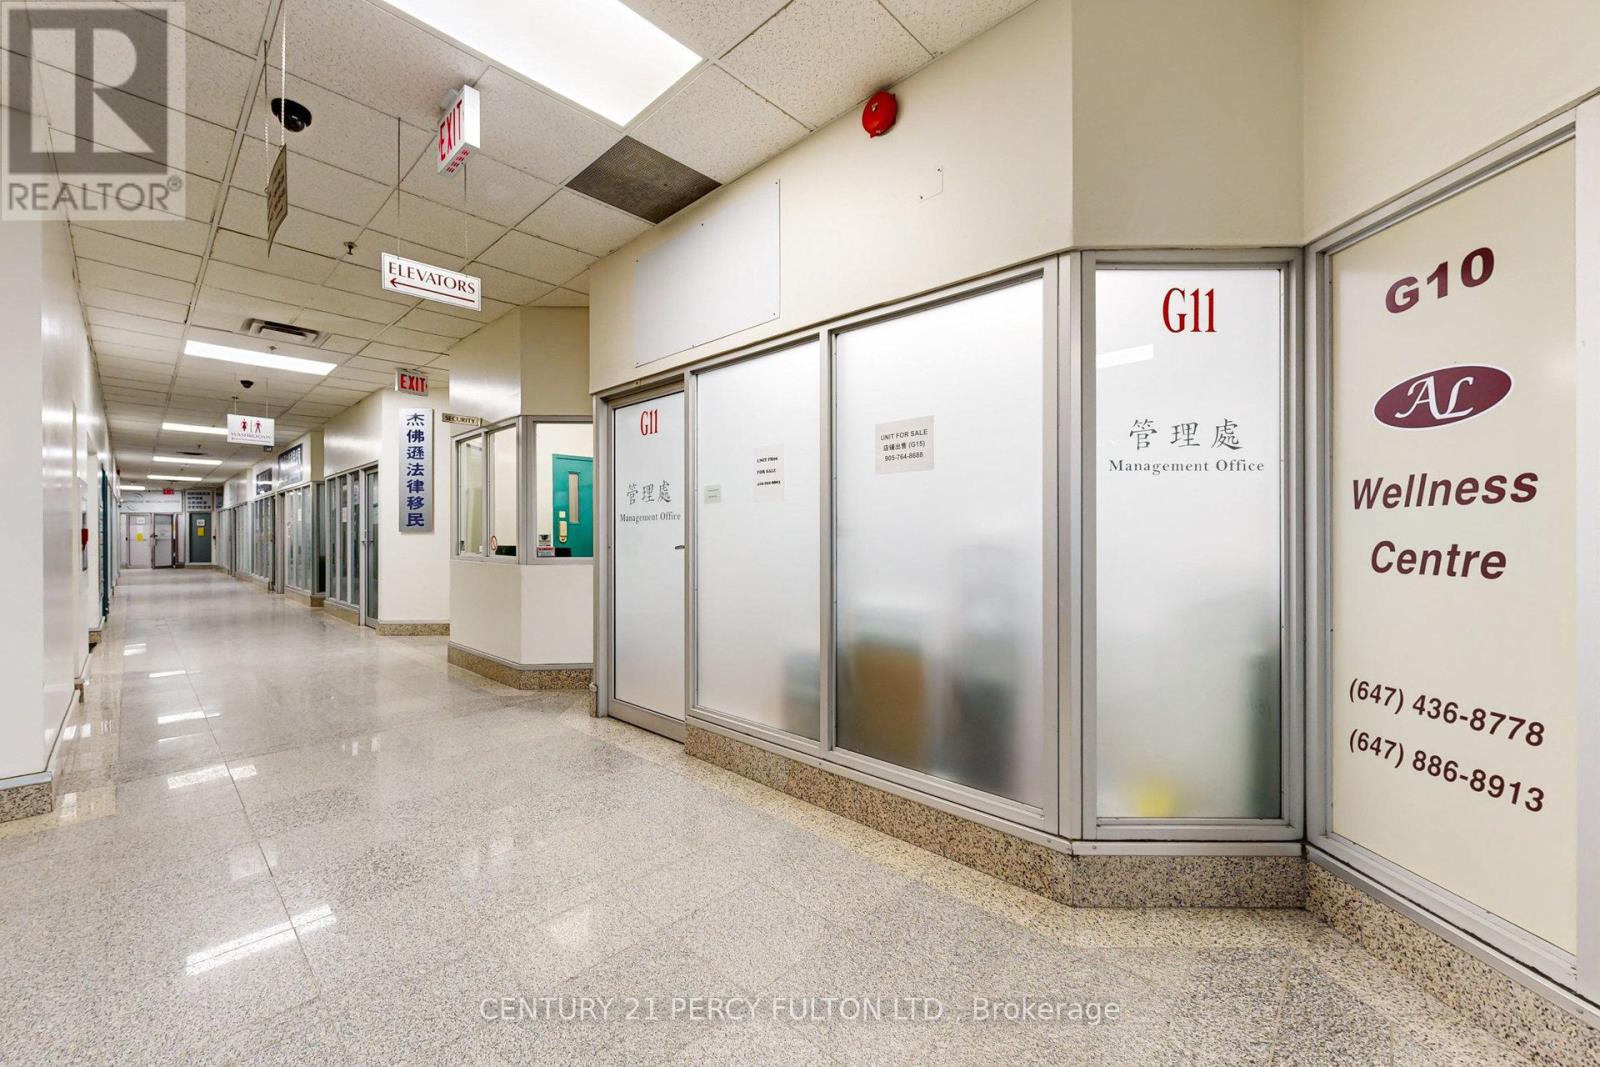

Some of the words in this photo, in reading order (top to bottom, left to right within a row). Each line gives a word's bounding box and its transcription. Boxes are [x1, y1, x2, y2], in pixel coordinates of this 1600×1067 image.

[439, 100, 462, 161] EXIT
[388, 261, 476, 295] ELEVATORS
[1385, 247, 1495, 314] G10
[1162, 287, 1217, 333] G11
[400, 373, 426, 393] EXIT
[444, 414, 477, 425] SECURITY
[640, 408, 659, 436] G11
[880, 433, 895, 441] UNIT
[910, 428, 928, 437] SALE
[1129, 417, 1244, 451] 管理處
[1109, 459, 1209, 476] Management
[1216, 458, 1265, 472] Office
[626, 479, 672, 506] 管理處
[1352, 472, 1539, 511] Wellness
[620, 512, 658, 525] Management
[659, 510, 681, 521] Office
[1371, 540, 1507, 580] Centre
[1349, 678, 1404, 714] (647)
[1412, 695, 1545, 747] 436-8778
[1349, 728, 1404, 768] (647)
[1412, 750, 1545, 812] 886-8913
